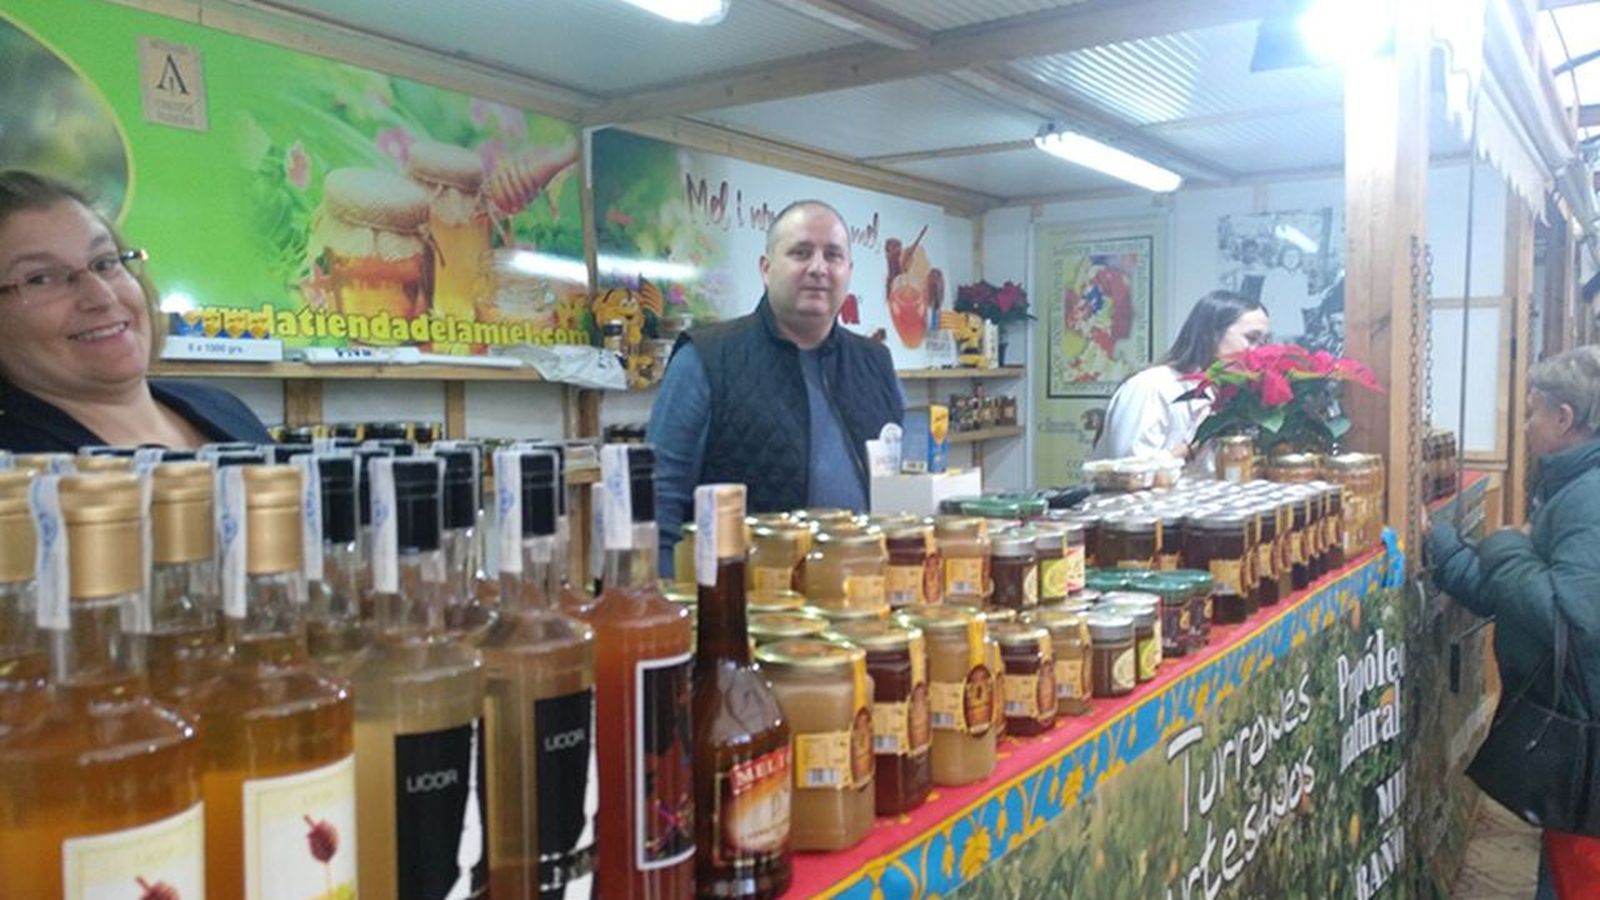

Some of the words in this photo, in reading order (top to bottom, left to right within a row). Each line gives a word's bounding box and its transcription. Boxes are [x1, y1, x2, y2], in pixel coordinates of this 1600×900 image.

[544, 728, 586, 751] LICOR
[406, 769, 459, 793] LICOR
[1167, 745, 1315, 900] rtesanos
